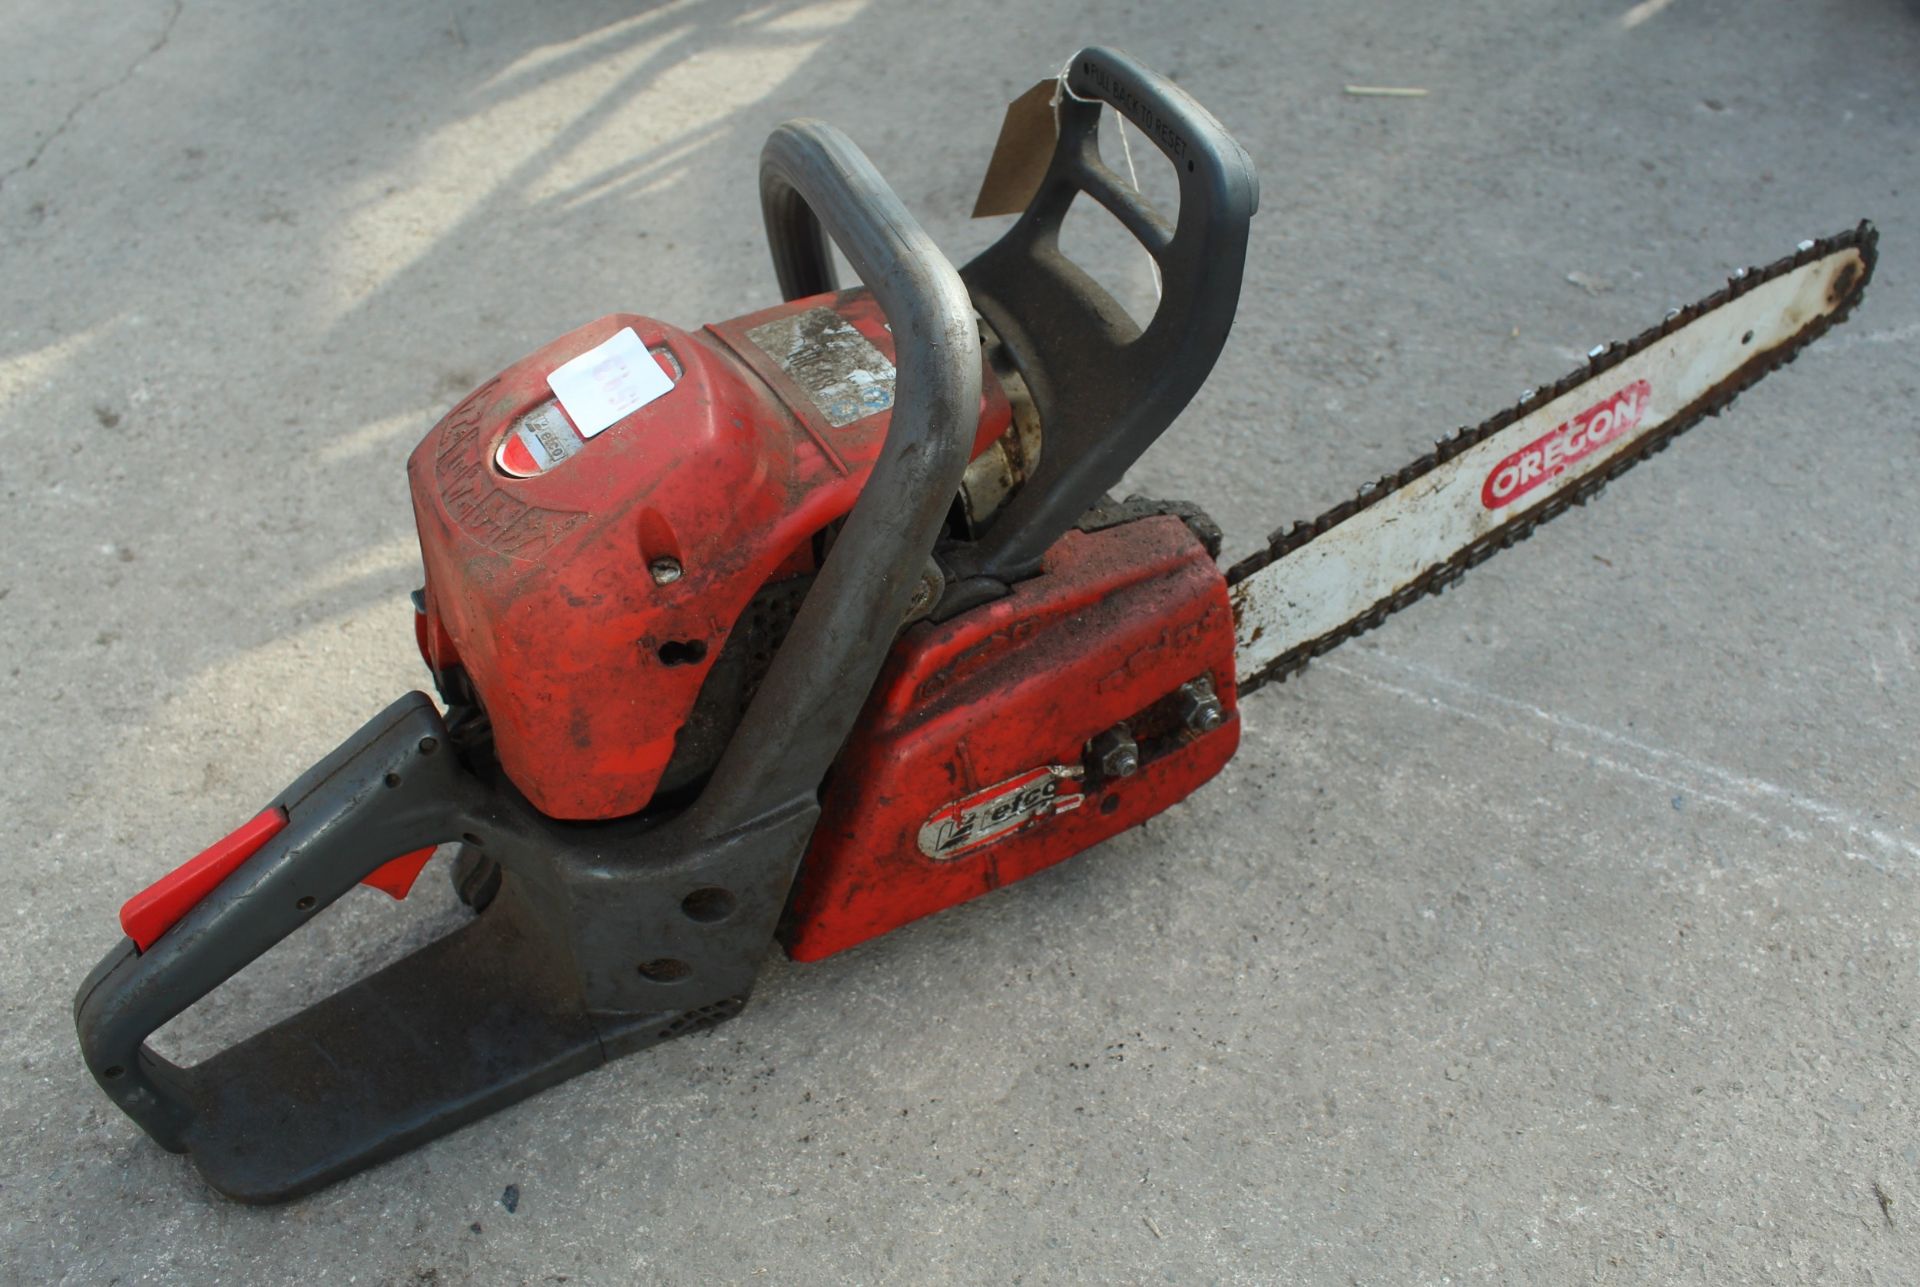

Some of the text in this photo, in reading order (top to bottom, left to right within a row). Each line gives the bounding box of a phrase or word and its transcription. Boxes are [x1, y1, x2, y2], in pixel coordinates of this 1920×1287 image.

[1090, 63, 1187, 160] PULL BACK TO RESET
[1492, 391, 1638, 498] OREGON
[991, 780, 1057, 821] efco
